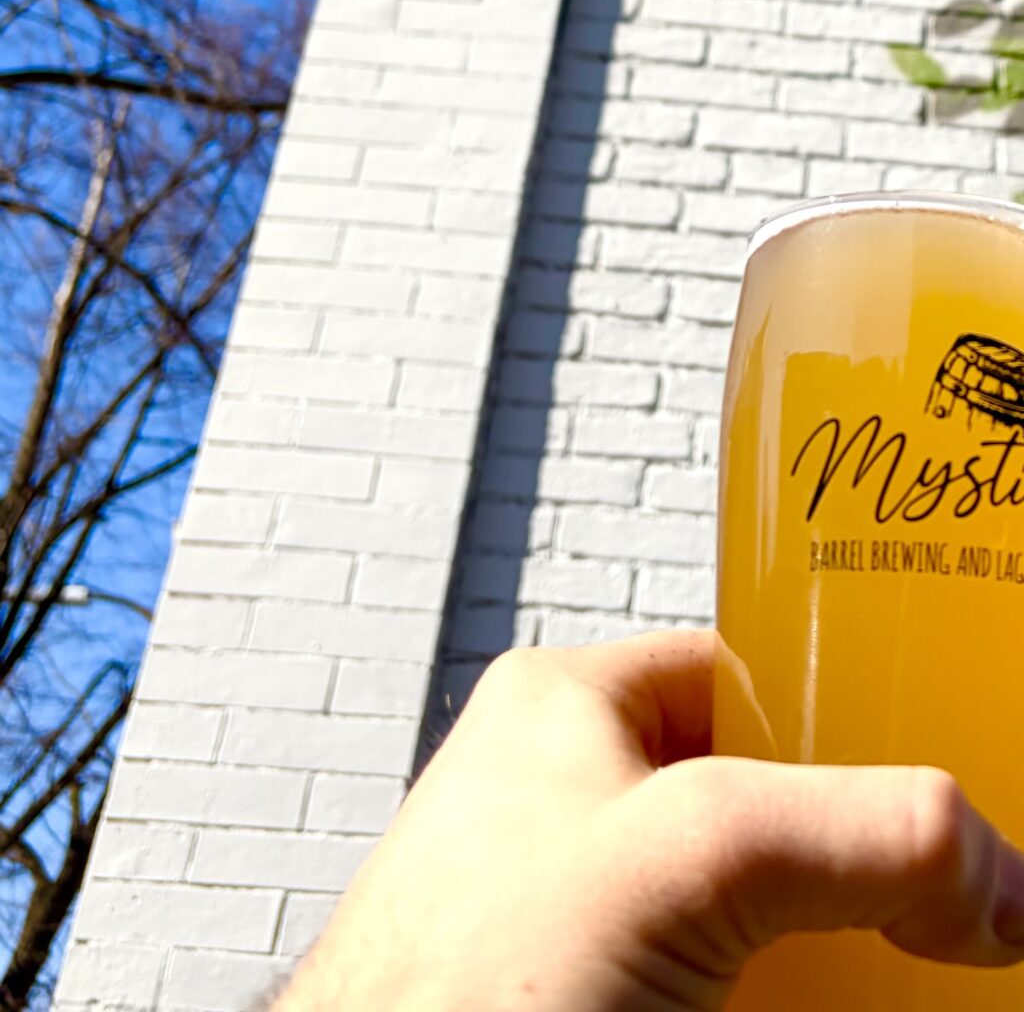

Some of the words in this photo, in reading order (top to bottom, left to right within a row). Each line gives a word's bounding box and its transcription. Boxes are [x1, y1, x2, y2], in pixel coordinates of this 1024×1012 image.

[810, 540, 864, 572] BARREL
[870, 540, 950, 575] BREWING
[956, 547, 991, 578] AND
